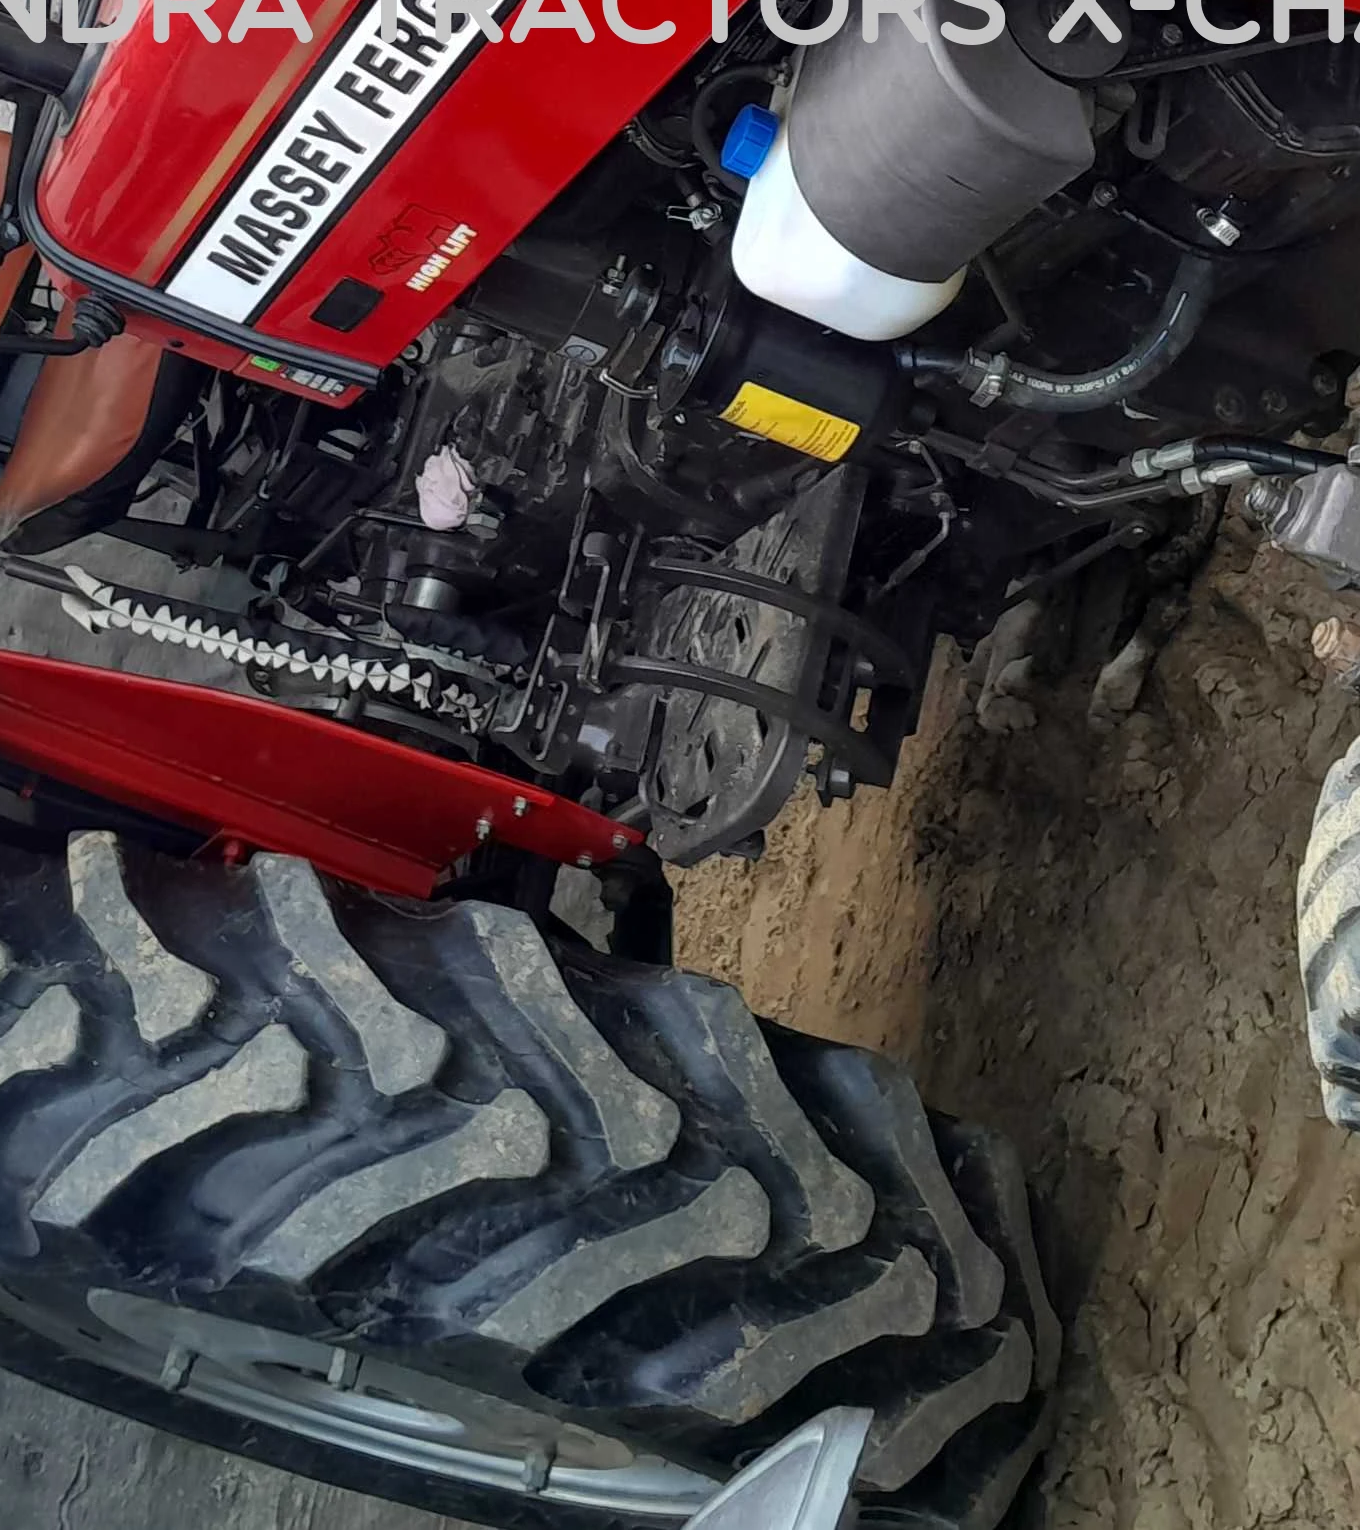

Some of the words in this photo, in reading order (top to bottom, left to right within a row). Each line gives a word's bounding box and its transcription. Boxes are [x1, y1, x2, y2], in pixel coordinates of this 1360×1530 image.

[208, 110, 368, 286] MASSEY
[406, 253, 452, 293] HIGH
[439, 222, 479, 258] LIFT
[1009, 371, 1025, 384] AE
